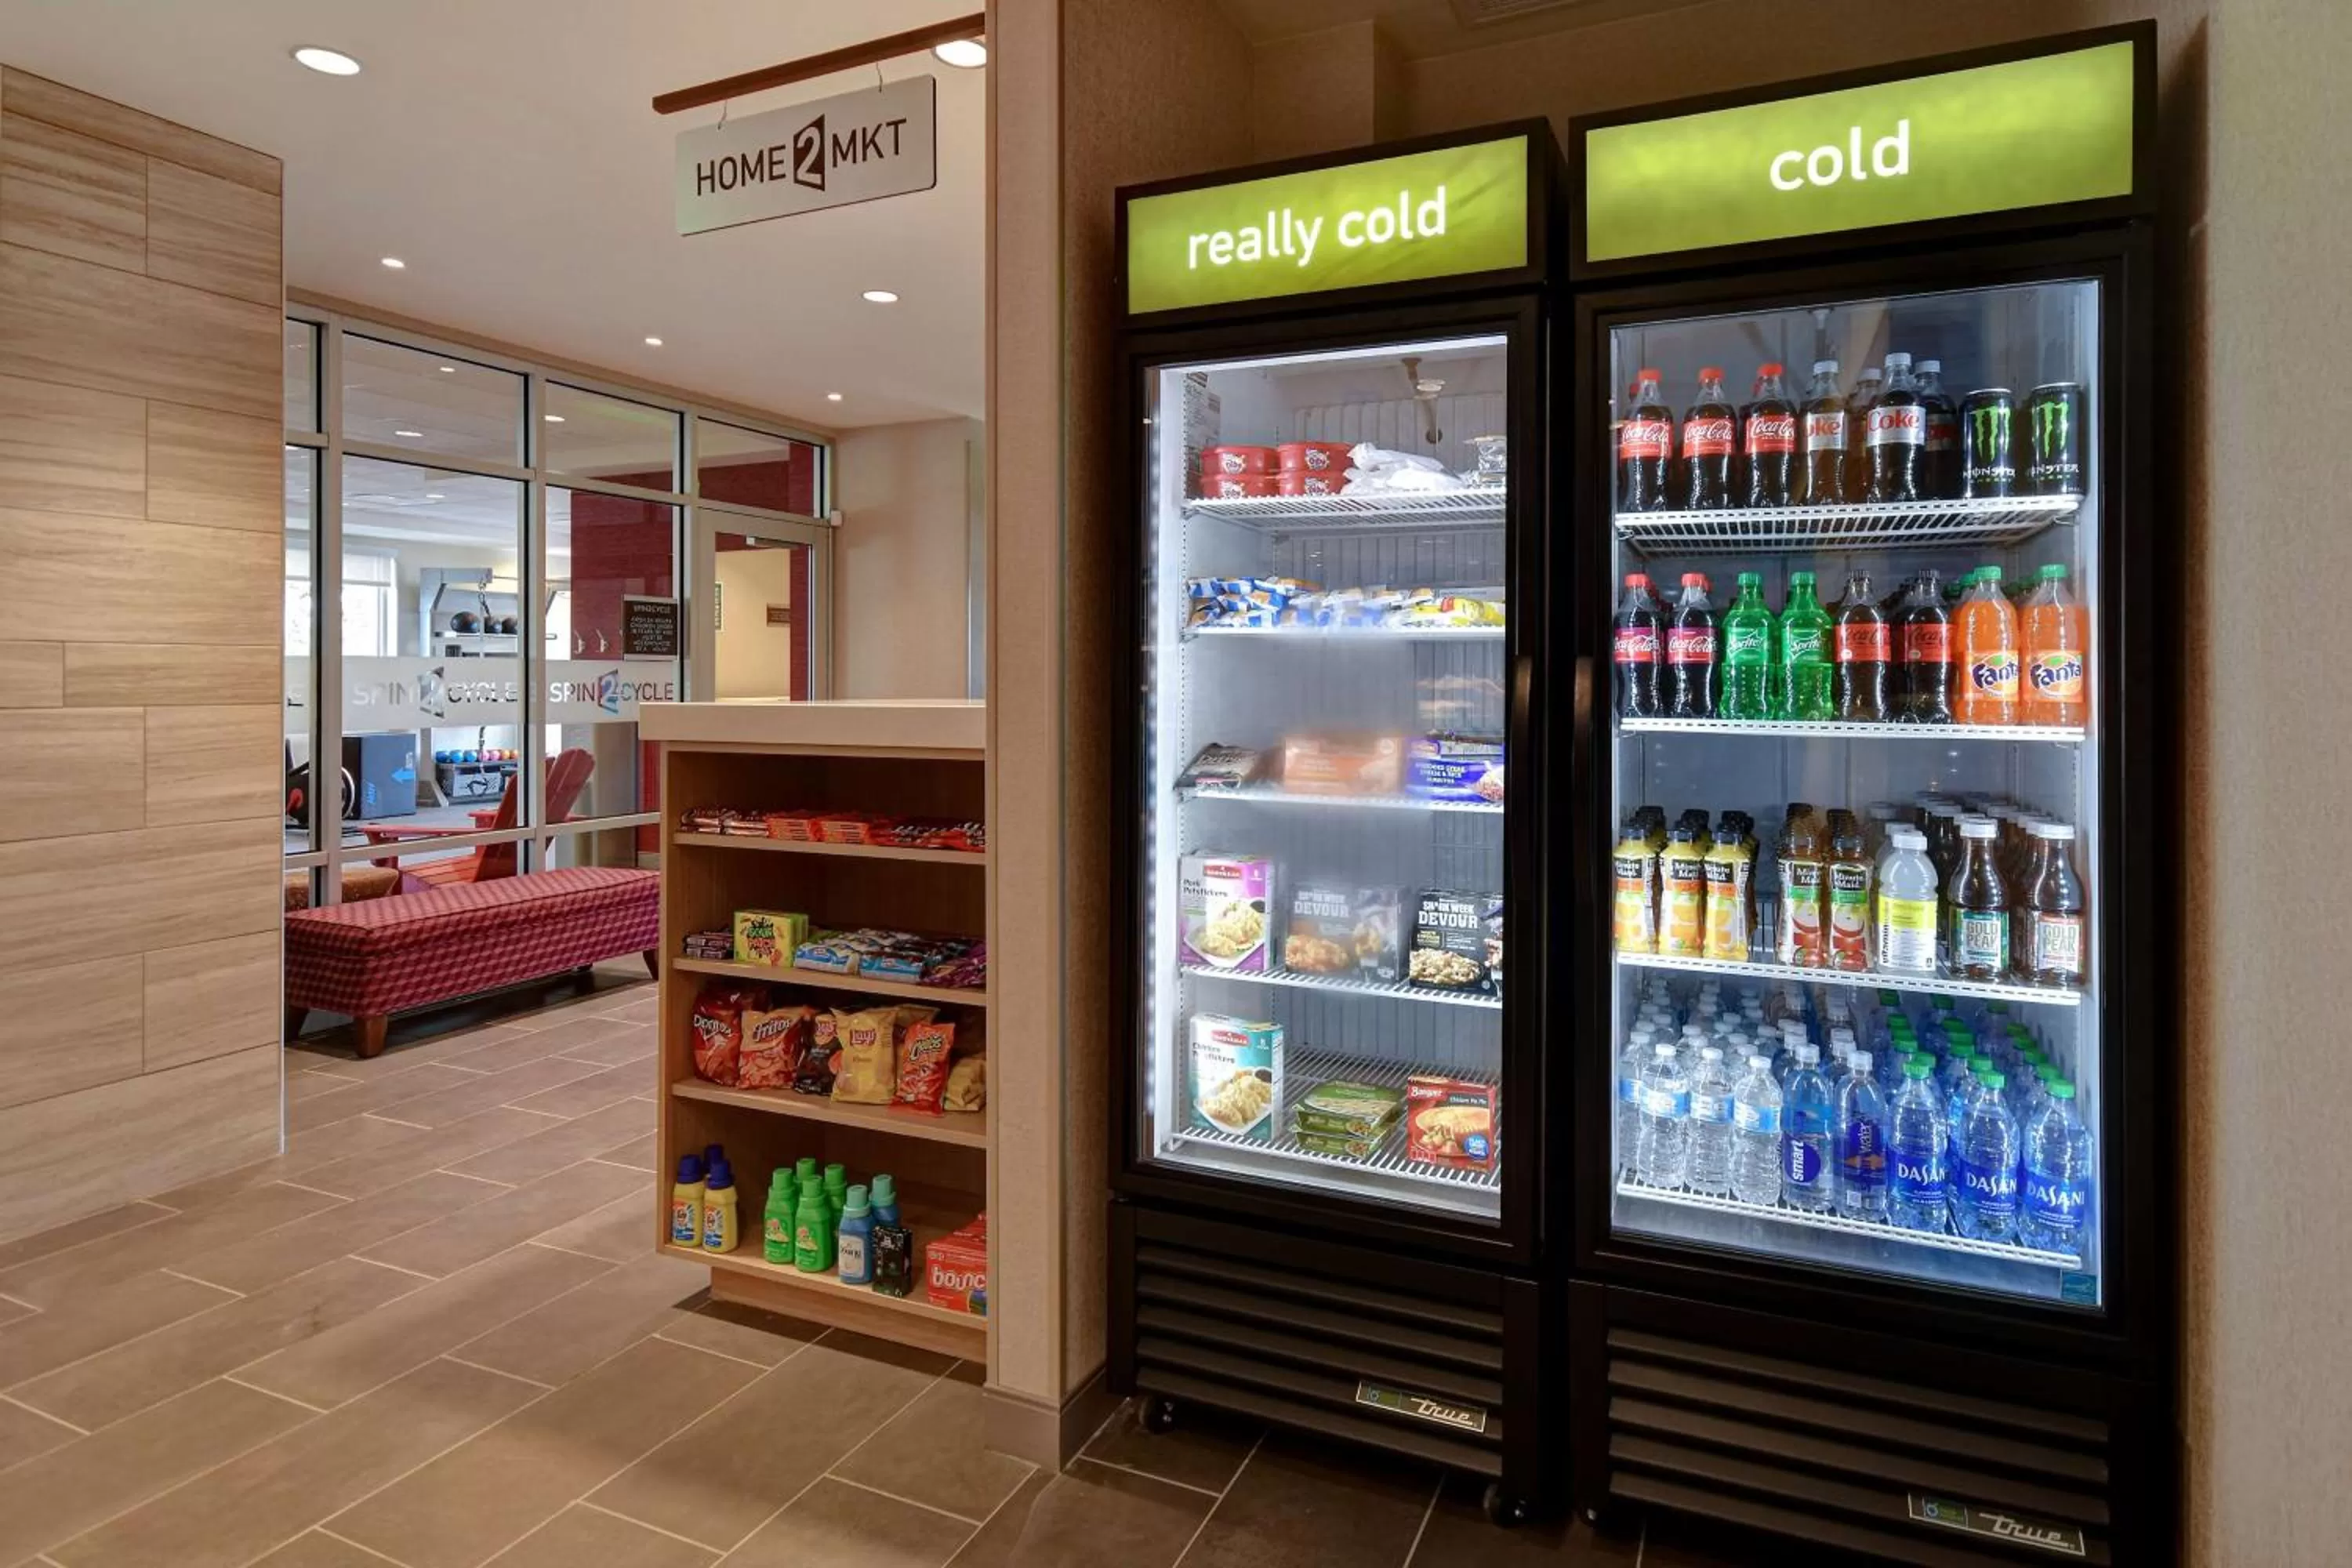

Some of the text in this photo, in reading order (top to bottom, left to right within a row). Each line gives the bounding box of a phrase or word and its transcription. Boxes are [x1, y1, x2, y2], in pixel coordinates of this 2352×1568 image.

[832, 118, 907, 167] MKT
[1769, 118, 1910, 191] cold
[1189, 186, 1446, 268] really cold
[1805, 416, 1841, 437] oke
[2031, 660, 2082, 689] Fanta
[621, 682, 674, 701] CYCLE
[1294, 901, 1349, 918] DEVOUR
[1418, 910, 1478, 929] DEVOUR
[1791, 1139, 1804, 1181] smart
[1897, 1162, 1945, 1185] DASAN
[1965, 1174, 2017, 1197] DASAN
[931, 1265, 986, 1290] bounc
[1410, 1398, 1473, 1425] True
[1978, 1512, 2070, 1548] True
